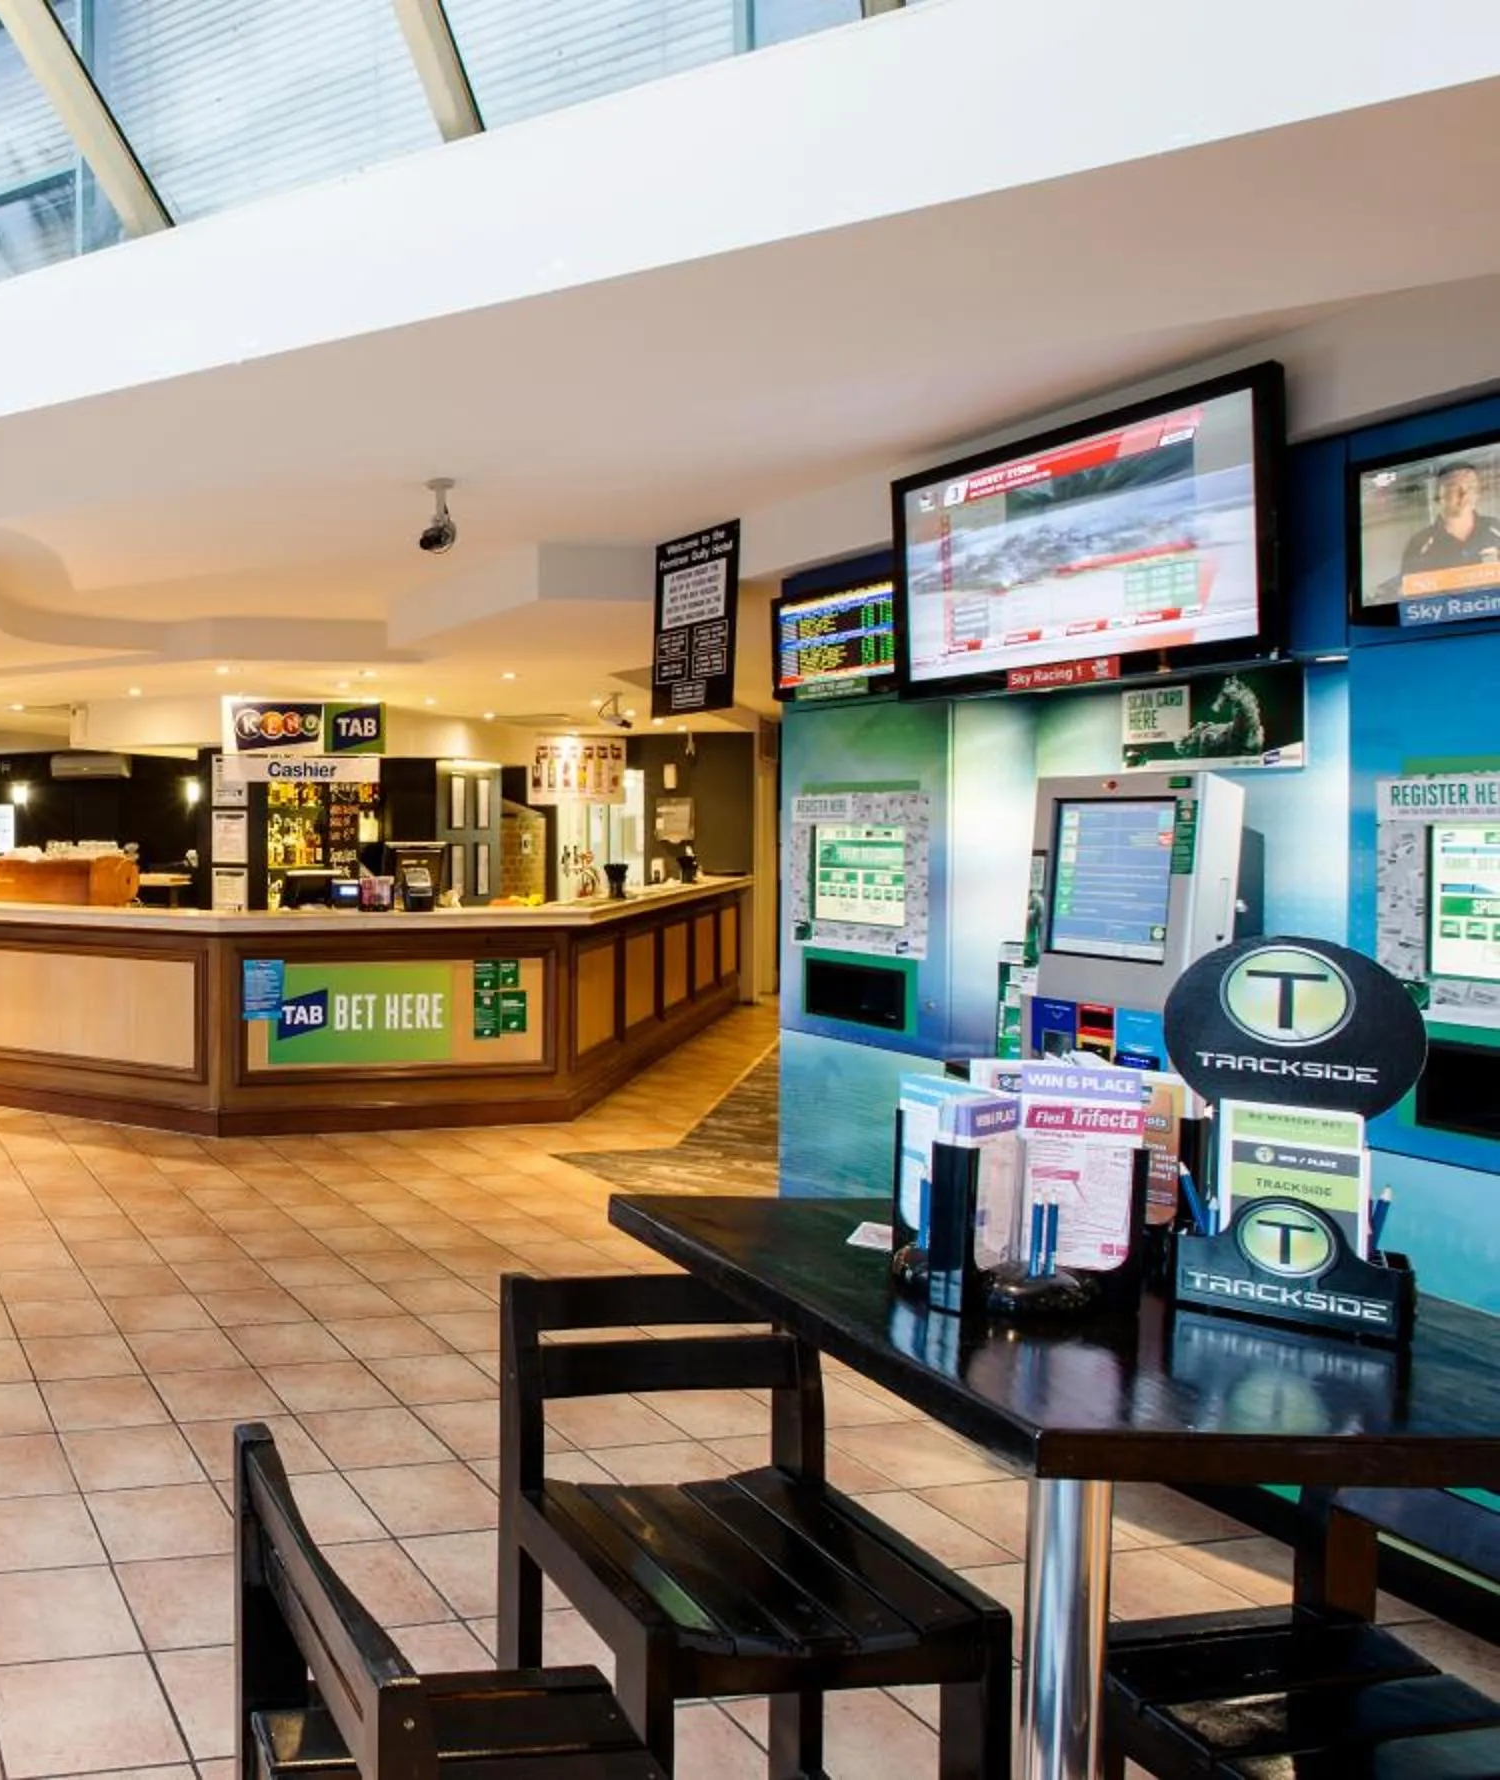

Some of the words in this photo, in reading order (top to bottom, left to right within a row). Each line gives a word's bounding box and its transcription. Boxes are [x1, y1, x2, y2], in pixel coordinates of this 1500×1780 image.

[1405, 604, 1443, 620] Sky
[1011, 673, 1033, 687] Sky
[1033, 667, 1073, 683] Racing
[1127, 692, 1153, 708] SCAN
[1156, 689, 1183, 708] CARD
[239, 711, 319, 737] KENO
[336, 717, 377, 737] TAB
[1129, 709, 1158, 730] HERE
[268, 761, 338, 779] Cashier
[1390, 782, 1469, 807] REGISTER
[282, 1004, 324, 1025] TAB
[333, 993, 378, 1031] BET
[384, 993, 445, 1030] HERE
[1195, 1051, 1380, 1085] TRACKSIDE
[1027, 1071, 1064, 1090] WIN
[1066, 1073, 1079, 1090] &
[1082, 1076, 1137, 1094] PLACE
[1034, 1110, 1066, 1126] Flexi
[1071, 1106, 1139, 1130] Trifecta
[1256, 1177, 1333, 1197] TRACKSIDE
[1186, 1270, 1388, 1323] TRACKSIDE
